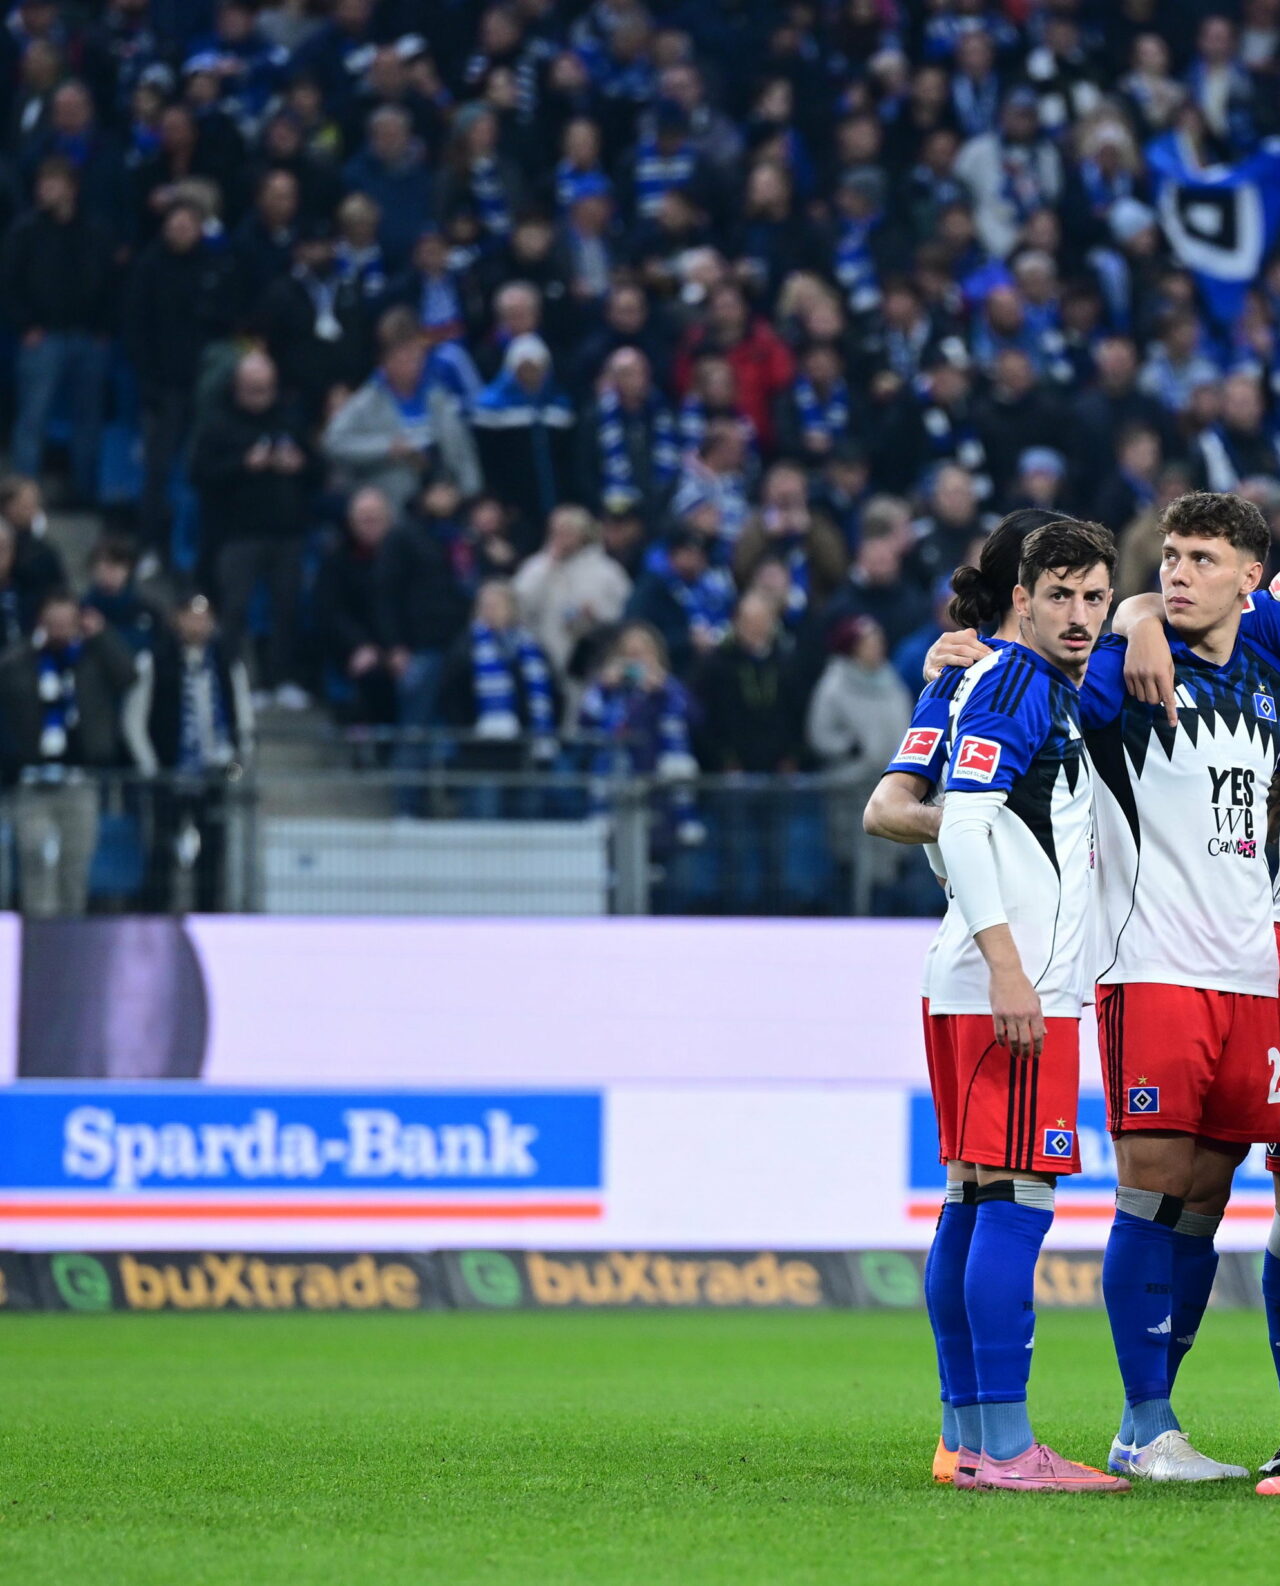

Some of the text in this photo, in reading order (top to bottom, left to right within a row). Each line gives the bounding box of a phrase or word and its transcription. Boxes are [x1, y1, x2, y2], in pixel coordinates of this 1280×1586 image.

[1207, 765, 1255, 808] YES
[1212, 807, 1254, 840] We
[63, 1106, 538, 1191] Sparda-Bank
[119, 1252, 420, 1309] buXtrade
[526, 1251, 822, 1306] buXtrade
